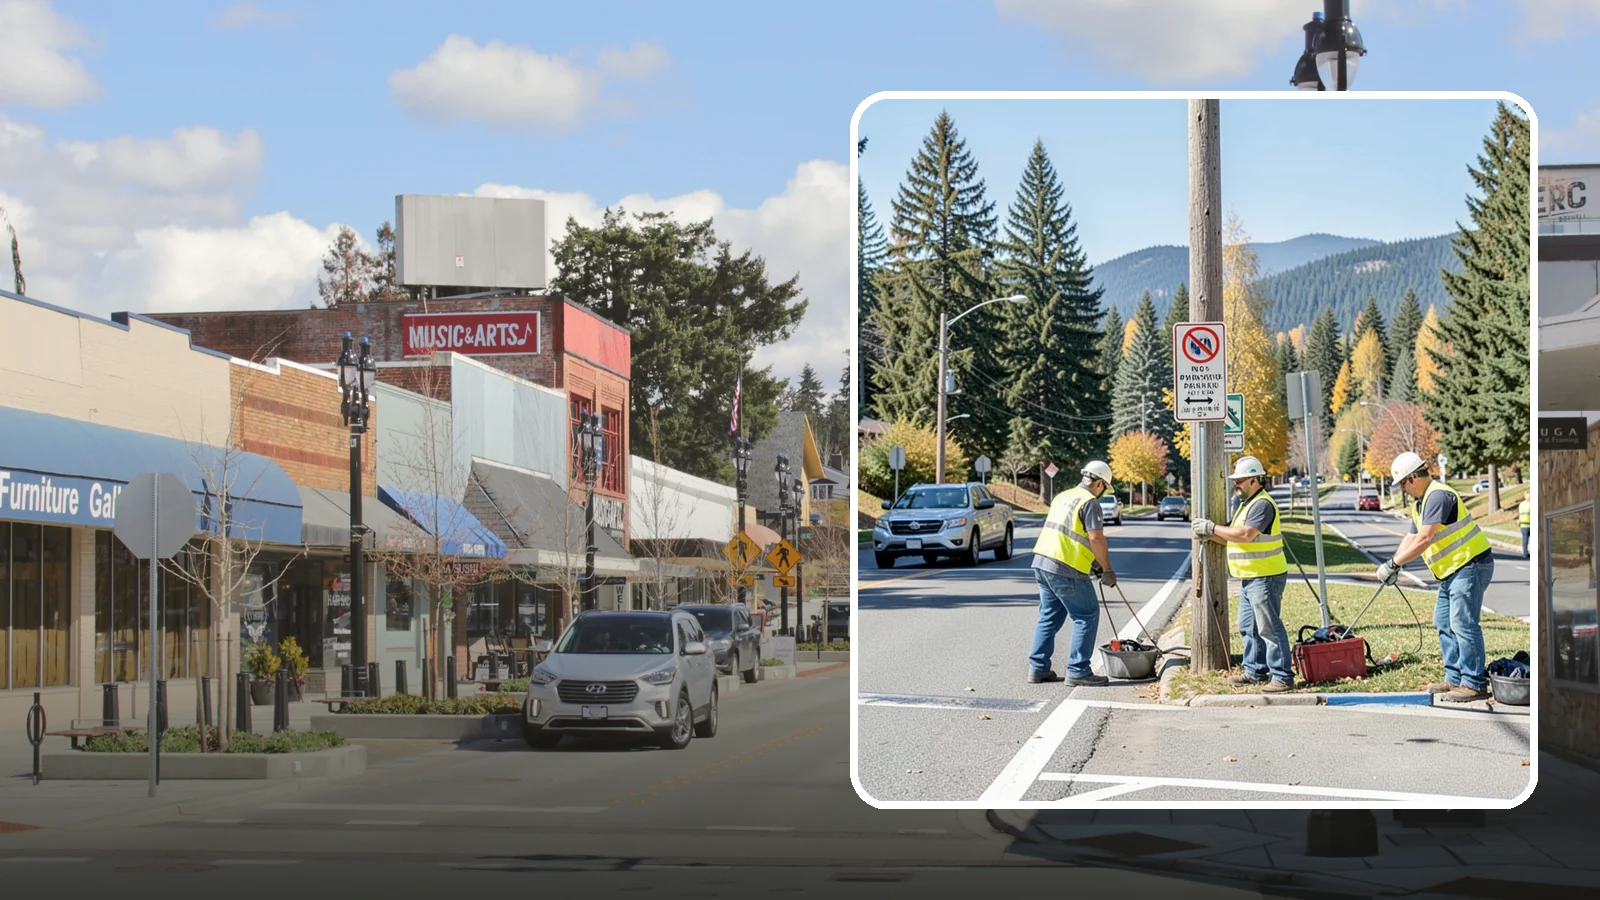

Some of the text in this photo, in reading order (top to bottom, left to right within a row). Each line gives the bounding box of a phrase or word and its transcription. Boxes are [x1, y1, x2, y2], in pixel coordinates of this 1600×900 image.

[1552, 436, 1579, 444] Framing
[0, 472, 121, 518] Furniture Gal
[453, 564, 479, 574] SUSHI
